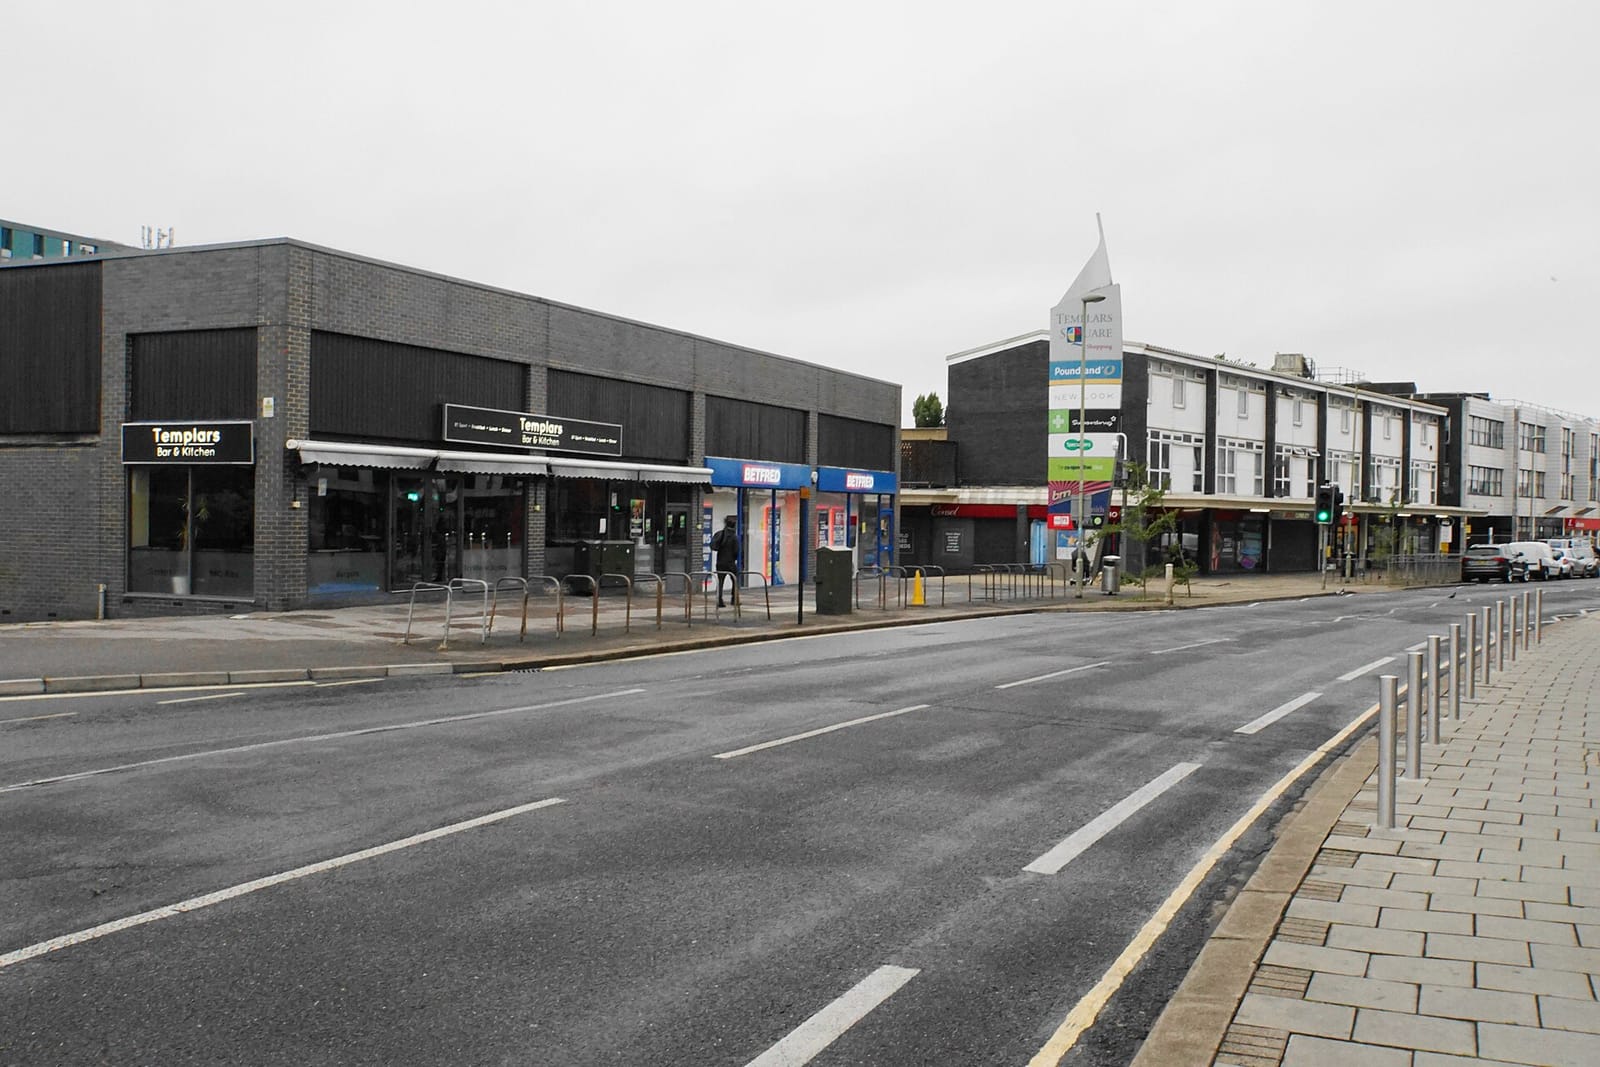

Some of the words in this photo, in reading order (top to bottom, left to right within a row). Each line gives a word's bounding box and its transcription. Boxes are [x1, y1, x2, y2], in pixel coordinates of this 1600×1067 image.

[1060, 328, 1112, 338] SUARE
[1054, 366, 1101, 376] Poundand
[1055, 392, 1078, 401] NEW
[520, 417, 563, 435] Templars
[1072, 419, 1112, 427] Suerdrug
[152, 427, 221, 446] Templars
[522, 435, 533, 445] Bar
[534, 436, 539, 445] &
[540, 436, 560, 446] Kitchen
[157, 447, 172, 457] Bar
[173, 448, 180, 457] &
[182, 447, 215, 457] Kitchen
[744, 467, 781, 483] BETFRED
[846, 474, 874, 488] BETFRED
